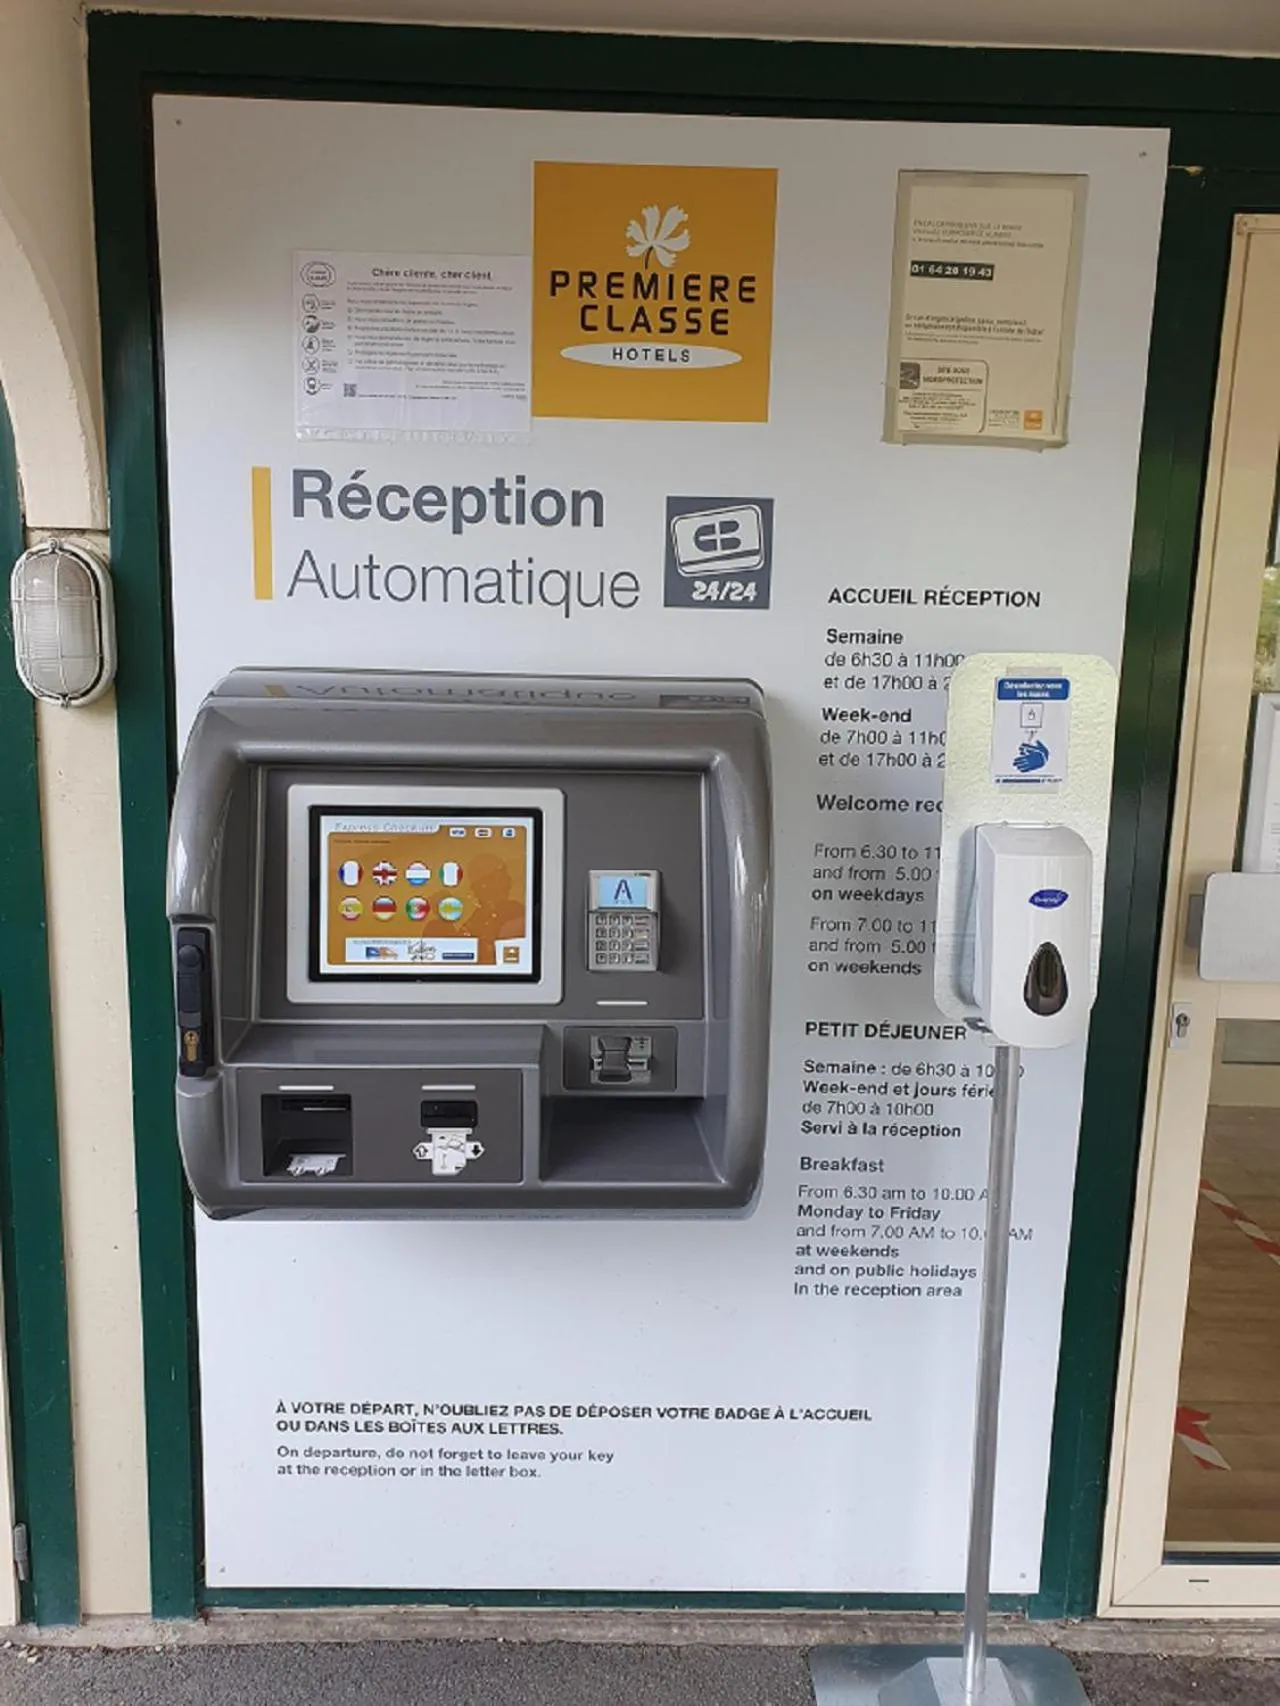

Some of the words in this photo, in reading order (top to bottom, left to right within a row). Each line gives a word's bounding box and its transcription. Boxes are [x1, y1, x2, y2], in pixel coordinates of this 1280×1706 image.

[549, 270, 757, 304] PREMIERE
[580, 304, 729, 336] CLASSE
[611, 346, 692, 363] HOTELS
[291, 468, 605, 535] Réception
[287, 548, 641, 619] Automatique
[691, 581, 758, 603] 24/24
[828, 587, 918, 605] ACCUEIL
[924, 584, 1042, 608] RÉCEPTION
[826, 628, 904, 645] Semaine
[824, 652, 846, 667] de
[851, 652, 893, 668] 6h30
[897, 652, 908, 668] à
[823, 677, 839, 690] et
[844, 675, 866, 690] de
[873, 676, 923, 691] 17h00
[927, 676, 938, 690] à
[821, 707, 912, 723] Week-end
[820, 730, 841, 745] de
[847, 731, 888, 745] 7h00
[892, 730, 902, 745] à
[909, 731, 947, 746] 11h0
[818, 753, 834, 768] et
[838, 752, 860, 768] de
[866, 753, 917, 769] 17h00
[921, 752, 932, 769] à
[816, 794, 910, 813] Welcome
[814, 843, 856, 860] From
[860, 844, 897, 860] 6.30
[901, 845, 919, 861] to
[812, 864, 843, 880] and
[848, 865, 886, 881] from
[895, 866, 932, 882] 5.00
[811, 887, 833, 902] on
[837, 886, 925, 906] weekdays
[809, 915, 851, 932] From
[857, 916, 892, 933] 7.00
[897, 917, 914, 934] to
[808, 938, 838, 953] and
[844, 938, 881, 954] from
[891, 939, 926, 955] 5.00
[807, 960, 829, 973] on
[835, 959, 923, 976] weekends
[805, 1021, 859, 1038] PETIT
[864, 1019, 967, 1041] DÉJEUNER
[803, 1059, 877, 1075] Semaine
[891, 1061, 913, 1077] de
[915, 1062, 956, 1078] 6h30
[959, 1061, 970, 1078] à
[803, 1080, 888, 1096] Week-end
[892, 1081, 910, 1096] et
[913, 1082, 957, 1099] jours
[802, 1100, 822, 1115] de
[827, 1101, 866, 1116] 7h00
[870, 1101, 880, 1116] à
[886, 1102, 934, 1117] 10h00
[800, 1119, 842, 1136] Servi
[847, 1120, 858, 1135] à
[862, 1121, 877, 1136] la
[882, 1122, 961, 1140] réception
[799, 1156, 885, 1173] Breakfast
[798, 1184, 838, 1199] From
[843, 1185, 877, 1200] 6.30
[882, 1188, 906, 1201] am
[910, 1187, 926, 1201] to
[933, 1187, 975, 1202] 10.00
[797, 1204, 863, 1221] Monday
[868, 1205, 884, 1219] to
[889, 1206, 941, 1223] Friday
[796, 1224, 826, 1238] and
[831, 1224, 866, 1239] from
[871, 1224, 904, 1239] 7.00
[908, 1225, 935, 1240] AM
[940, 1226, 956, 1241] to
[795, 1245, 812, 1258] at
[816, 1244, 900, 1259] weekends
[794, 1263, 825, 1277] and
[829, 1266, 850, 1277] on
[855, 1264, 905, 1280] public
[909, 1264, 977, 1282] holidays
[814, 1282, 840, 1297] the
[843, 1283, 921, 1299] reception
[926, 1285, 962, 1298] area
[275, 1399, 287, 1415] À
[291, 1401, 345, 1415] VOTRE
[350, 1400, 419, 1418] DÉPART,
[423, 1403, 509, 1417] N'OUBLIEZ
[514, 1404, 546, 1418] PAS
[550, 1405, 572, 1418] DE
[576, 1403, 652, 1419] DÉPOSER
[656, 1406, 710, 1420] VOTRE
[714, 1407, 770, 1420] BADGE
[774, 1405, 785, 1420] À
[789, 1408, 872, 1422] L'ACCUEIL
[276, 1420, 301, 1433] OU
[304, 1420, 350, 1433] DANS
[354, 1420, 384, 1434] LES
[451, 1421, 485, 1435] AUX
[489, 1422, 564, 1436] LETTRES.
[276, 1445, 299, 1458] On
[302, 1446, 381, 1461] departure,
[385, 1447, 405, 1459] do
[409, 1447, 433, 1460] not
[437, 1447, 484, 1462] forget
[487, 1448, 501, 1460] to
[506, 1448, 546, 1461] leave
[550, 1452, 582, 1464] your
[588, 1449, 615, 1465] key
[276, 1464, 293, 1476] at
[296, 1463, 321, 1476] the
[324, 1464, 396, 1478] reception
[399, 1466, 417, 1477] or
[420, 1465, 434, 1477] in
[438, 1464, 462, 1478] the
[465, 1465, 505, 1478] letter
[509, 1465, 542, 1479] box.
